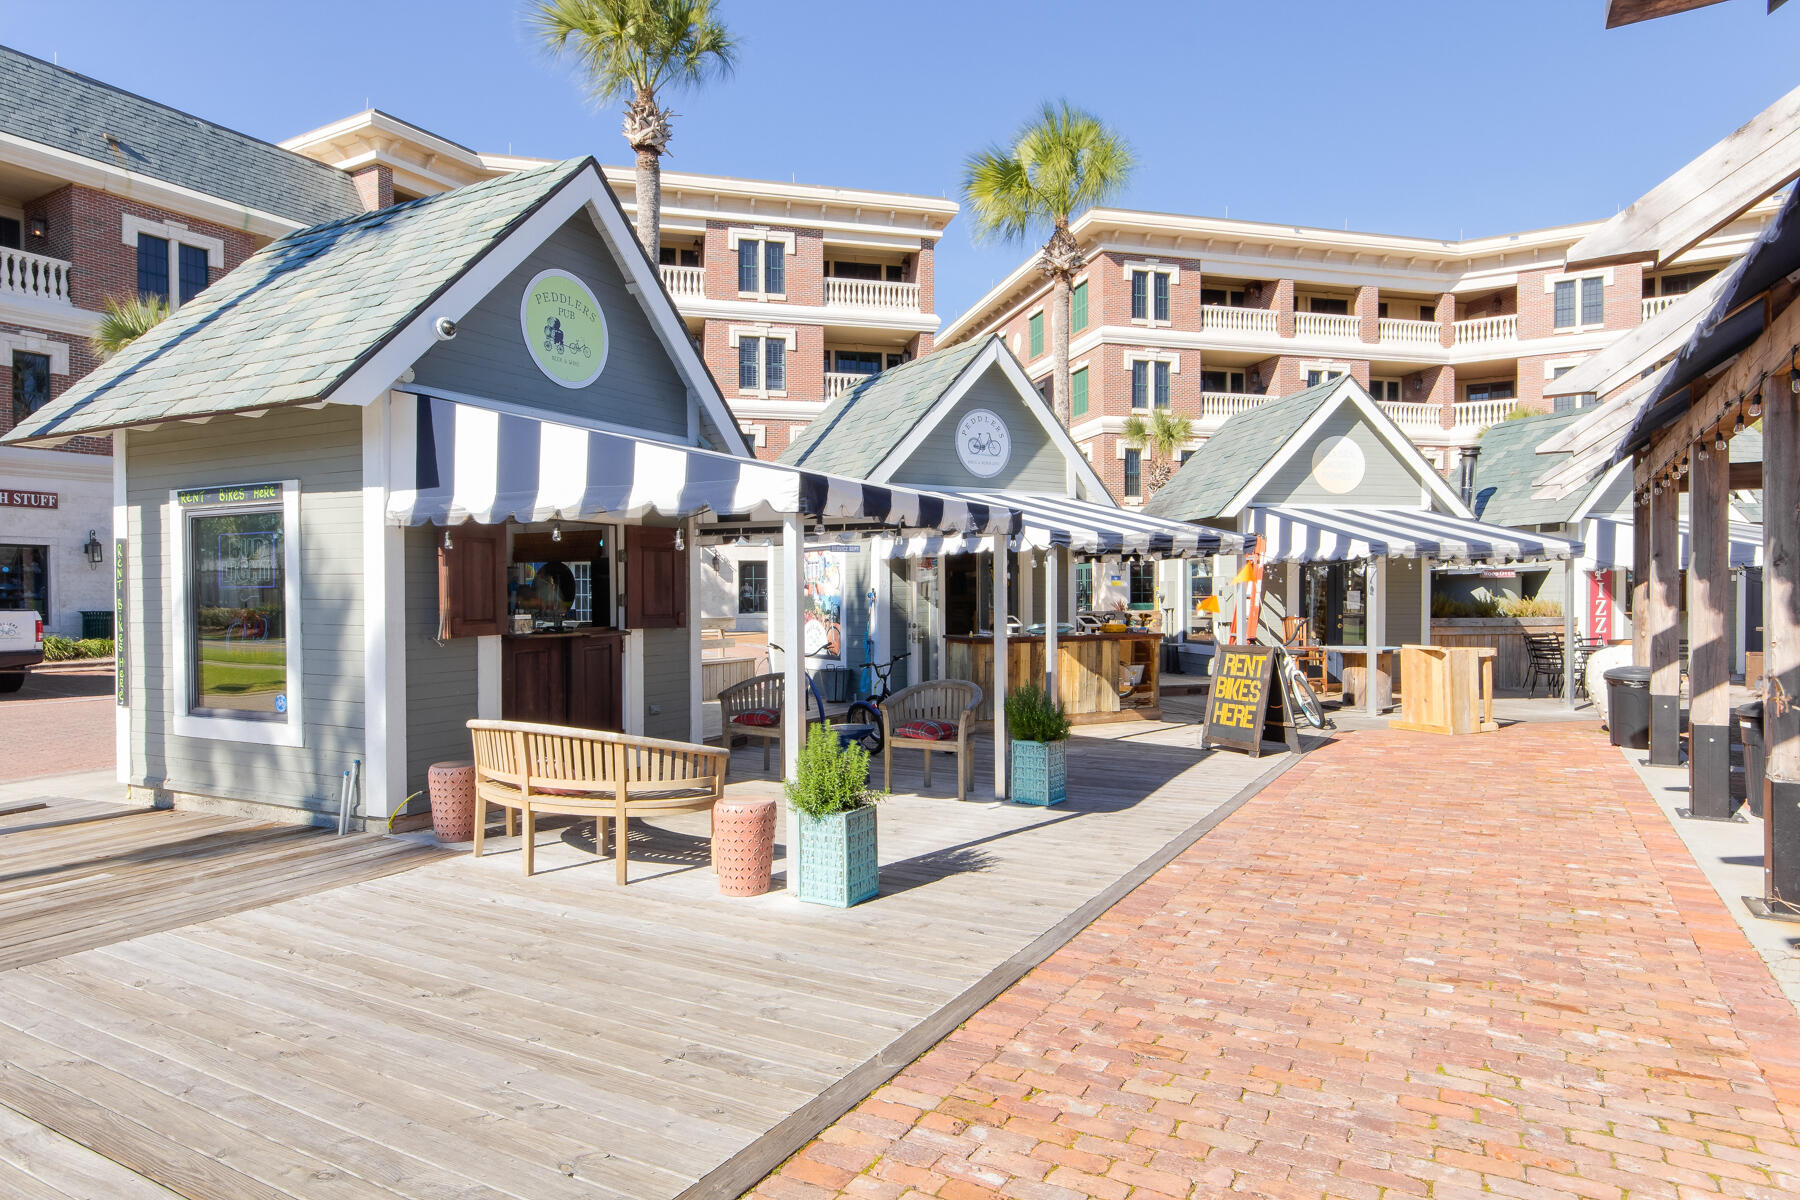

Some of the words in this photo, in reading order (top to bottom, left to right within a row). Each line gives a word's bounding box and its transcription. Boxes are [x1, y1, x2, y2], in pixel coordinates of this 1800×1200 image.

[535, 291, 597, 322] PEDDLERS
[557, 307, 576, 320] PUB
[962, 415, 1005, 439] PEDDLERS
[13, 492, 57, 506] STUFF
[1594, 567, 1608, 648] PIZZA
[1222, 653, 1267, 678] RENT
[1214, 676, 1262, 703] BIKES
[1211, 702, 1257, 728] HERE
